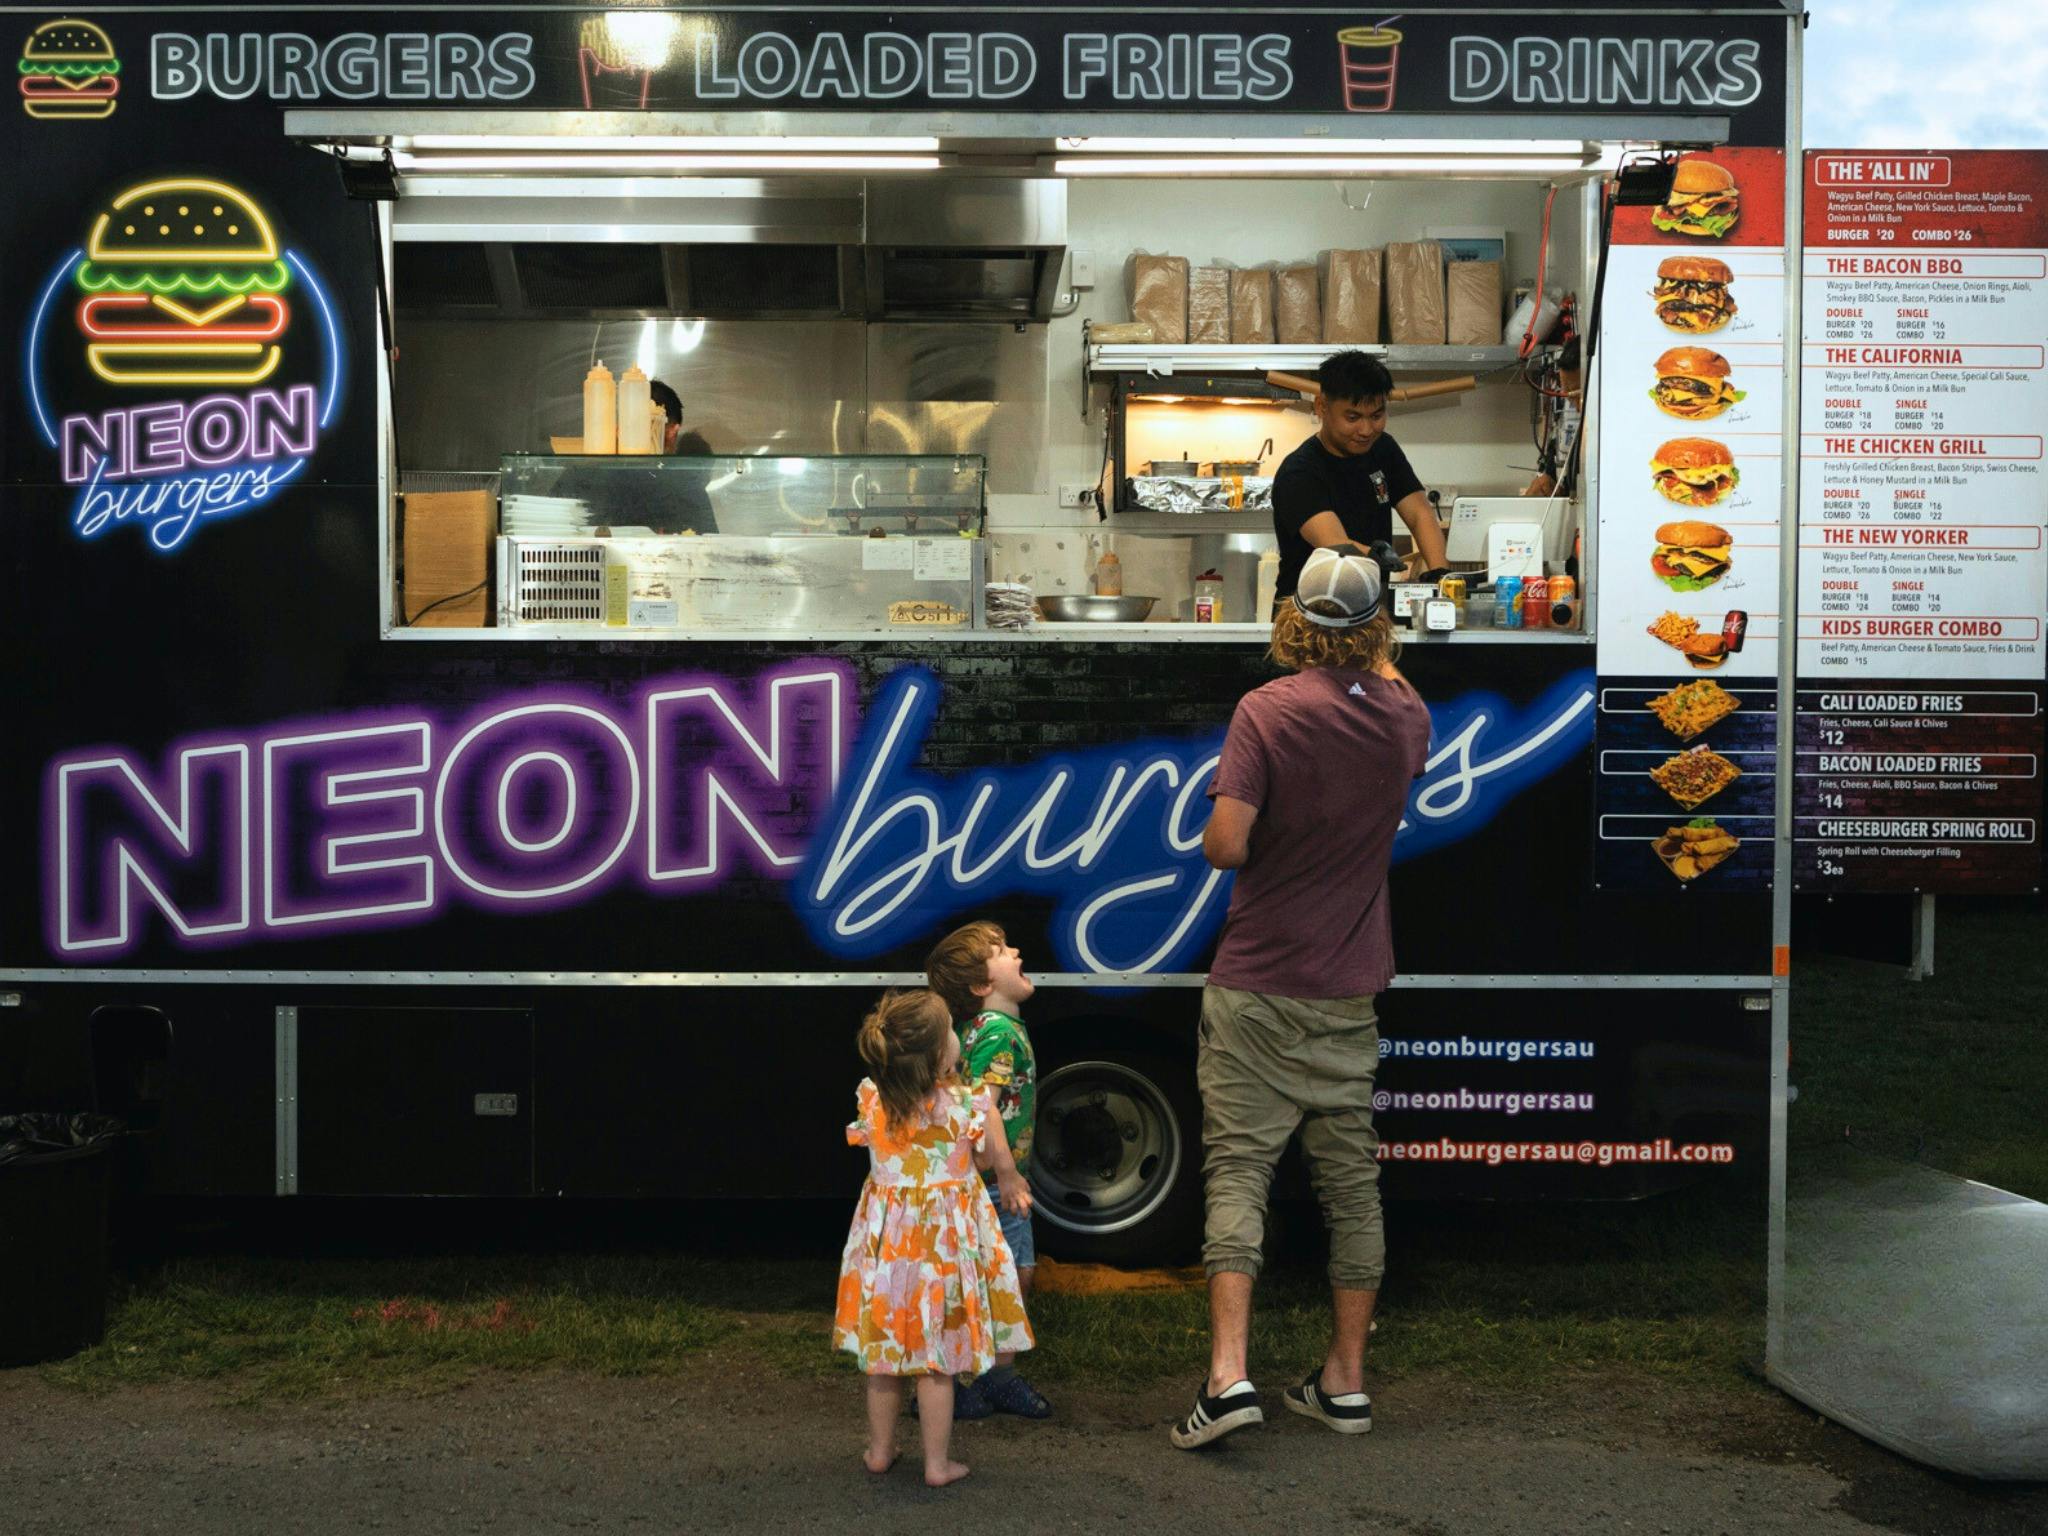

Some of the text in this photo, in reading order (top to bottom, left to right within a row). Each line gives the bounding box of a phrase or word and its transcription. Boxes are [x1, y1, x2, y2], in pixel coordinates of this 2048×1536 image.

[151, 33, 536, 100] BURGERS
[695, 31, 1293, 100] LOADED FRIES
[1450, 36, 1762, 106] DRINKS
[1828, 161, 1935, 181] THE 'ALL IN'
[1827, 191, 1854, 203] Wagyu
[1855, 191, 1873, 201] Beef
[1896, 191, 1922, 201] Grilled
[1923, 191, 1954, 201] Chicken
[1982, 191, 2006, 203] Maple
[1827, 202, 1864, 211] American
[1896, 203, 1913, 212] New
[1914, 203, 1930, 212] York
[1988, 203, 2016, 212] Tomato
[1828, 229, 1895, 240] BURGER $20
[1911, 229, 1972, 241] COMBO $26
[1826, 258, 1963, 274] THE BACON BBQ
[1826, 281, 1853, 292] Wagyu
[1854, 280, 1872, 290] Beef
[1894, 281, 1930, 290] American
[1962, 281, 1986, 291] Onion
[1826, 308, 1863, 318] DOUBLE
[1897, 308, 1929, 318] SINGLE
[1826, 320, 1856, 328] BURGER
[1896, 320, 1926, 329] BURGER
[1826, 330, 1854, 338] COMBO
[1896, 330, 1924, 339] COMBO
[1825, 348, 1963, 364] THE CALIFORNIA
[1825, 370, 1851, 381] Wagyu
[1853, 370, 1870, 379] Beef
[1893, 371, 1929, 380] American
[1961, 371, 1988, 382] Special
[1825, 399, 1861, 408] DOUBLE
[1895, 399, 1927, 409] SINGLE
[1825, 411, 1855, 419] BURGER
[1895, 411, 1925, 420] BURGER
[1824, 421, 1852, 429] COMBO
[1894, 421, 1923, 430] COMBO
[62, 387, 314, 482] NEON
[1824, 438, 1987, 454] THE CHICKEN GRILL
[1824, 462, 1851, 473] Freshly
[1852, 462, 1878, 471] Grilled
[1879, 462, 1909, 472] Chicken
[1937, 462, 1961, 472] Bacon
[1986, 463, 2008, 473] Swiss
[1823, 489, 1860, 498] DOUBLE
[1894, 489, 1925, 500] SINGLE
[76, 458, 306, 549] burgers
[1823, 501, 1853, 509] BURGER
[1893, 501, 1923, 510] BURGER
[1823, 511, 1851, 519] COMBO
[1893, 511, 1921, 520] COMBO
[1823, 529, 1968, 544] THE NEW YORKER
[1822, 581, 1859, 590] DOUBLE
[1892, 581, 1924, 591] SINGLE
[1822, 593, 1851, 601] BURGER
[1892, 593, 1921, 602] BURGER
[1821, 603, 1850, 611] COMBO
[1891, 603, 1920, 612] COMBO
[1822, 620, 2002, 636] KIDS BURGER COMBO
[1820, 642, 1838, 652] Beef
[1861, 643, 1896, 652] American
[1897, 643, 1926, 652] Cheese
[1934, 643, 1962, 653] Tomato
[1988, 644, 2006, 653] Fries
[2015, 644, 2035, 653] Drink
[1820, 657, 1849, 665] COMBO
[1820, 694, 1963, 711] CALI LOADED FRIES
[1873, 718, 1888, 727] Cali
[1890, 718, 1913, 728] Sauce
[1921, 718, 1948, 728] Chives
[1819, 729, 1844, 745] $12
[1820, 756, 1982, 772] BACON LOADED FRIES
[1894, 780, 1911, 789] BBQ
[1939, 780, 1963, 790] Bacon
[1972, 780, 1998, 790] Chives
[1818, 793, 1843, 808] $14
[59, 671, 1595, 974] NEON burgs
[1817, 821, 2025, 838] CHEESEBURGER SPRING ROLL
[1817, 846, 1961, 859] Spring Roll with Cheeseburger Filling
[1817, 860, 1844, 875] $3ea
[1378, 1036, 1595, 1061] @neonburgersau
[1373, 1088, 1594, 1115] @neonburgersau
[1376, 1138, 1734, 1165] neonburgersau@gmail.com
